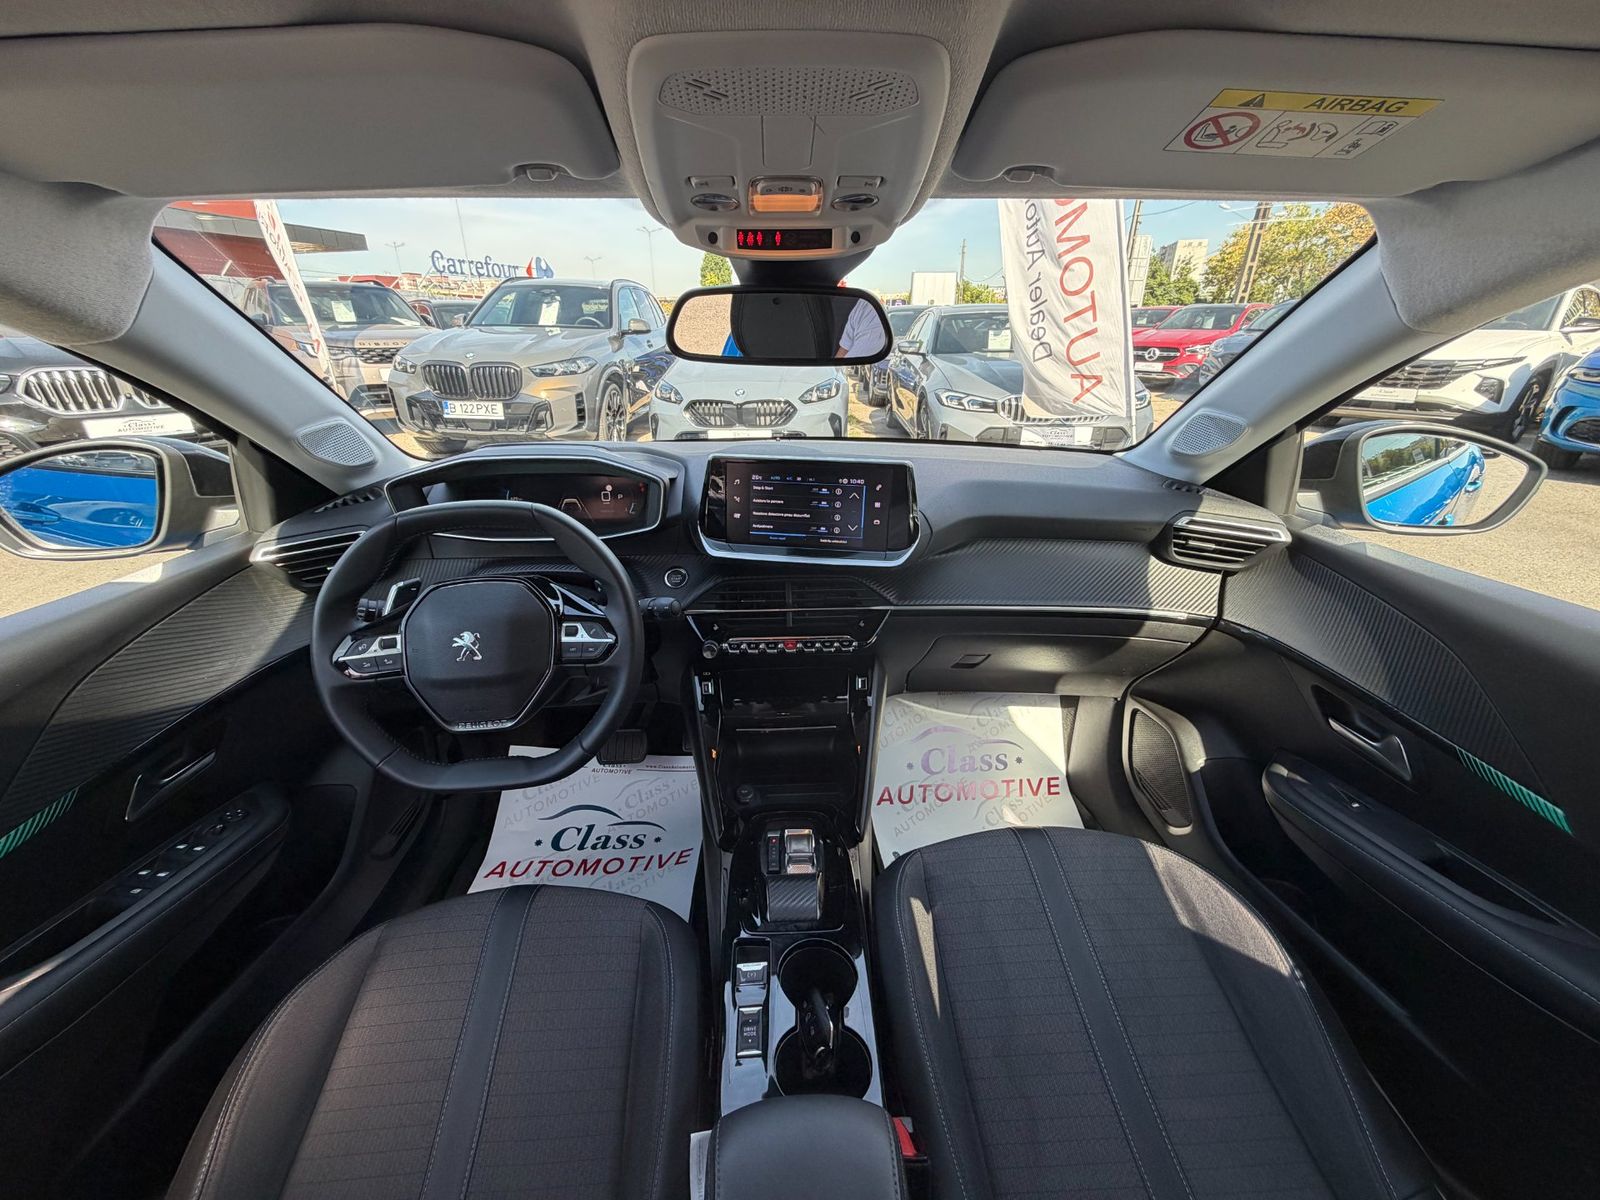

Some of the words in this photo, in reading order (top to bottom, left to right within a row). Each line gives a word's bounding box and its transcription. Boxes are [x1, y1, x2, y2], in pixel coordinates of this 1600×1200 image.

[1303, 97, 1409, 114] AIRBAG
[431, 250, 519, 279] Carrefour
[449, 402, 457, 414] B
[457, 719, 508, 730] PEUGEOT
[591, 767, 633, 775] AUTOMOTIVE
[920, 744, 1009, 775] Class
[876, 776, 1061, 806] AUTOMOTIVE
[551, 824, 647, 852] Class
[483, 847, 694, 879] AUTOMOTIVE
